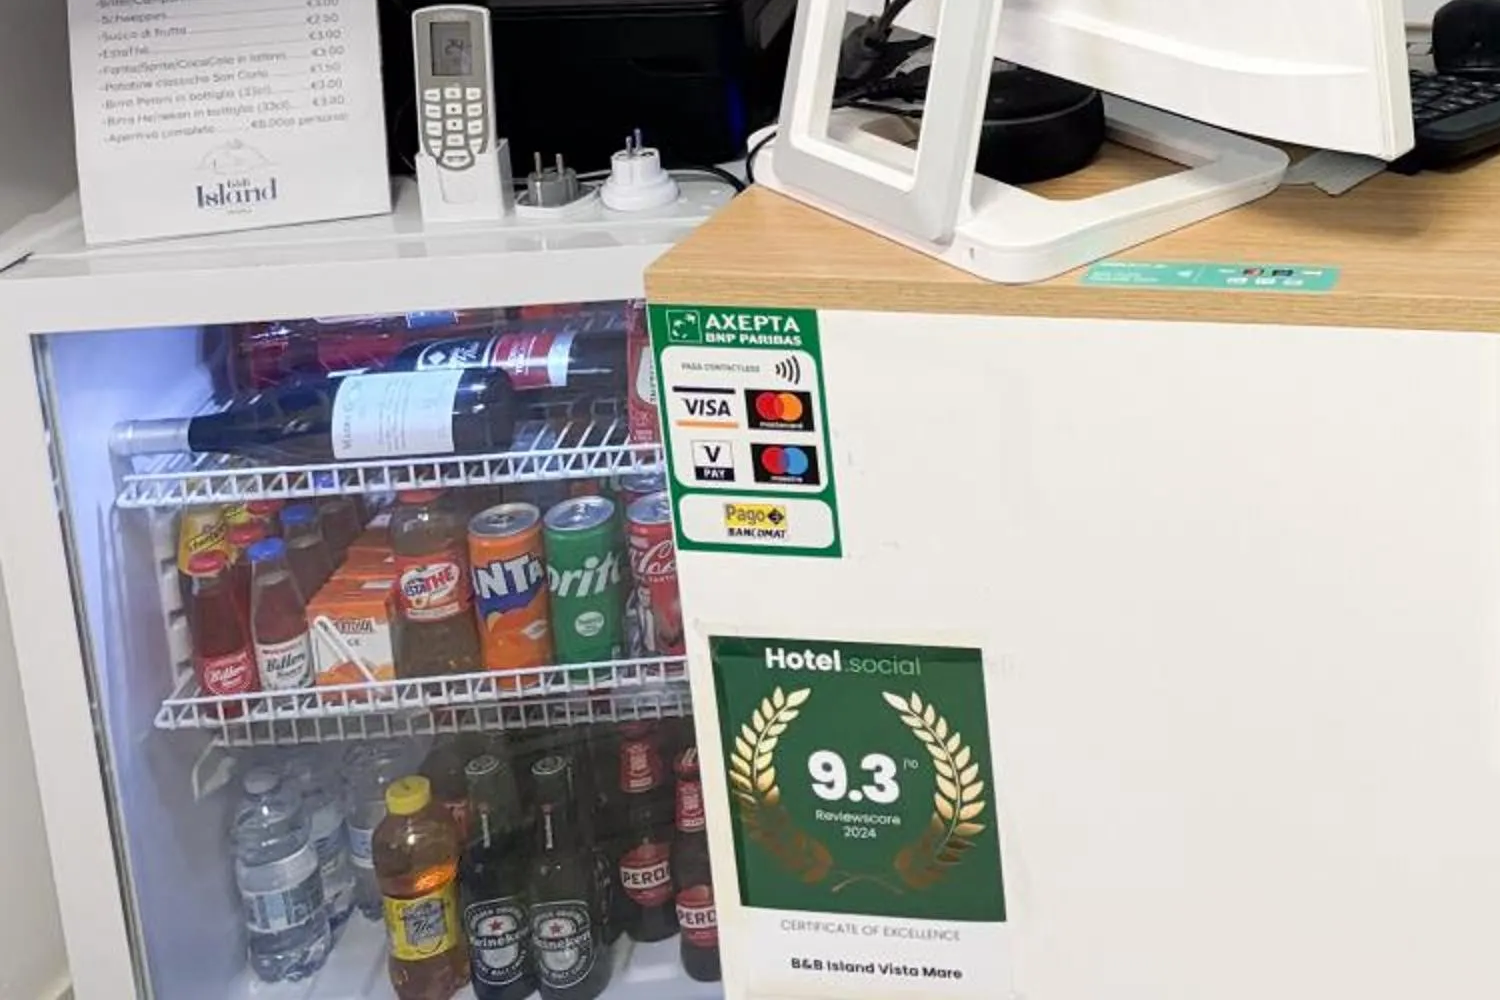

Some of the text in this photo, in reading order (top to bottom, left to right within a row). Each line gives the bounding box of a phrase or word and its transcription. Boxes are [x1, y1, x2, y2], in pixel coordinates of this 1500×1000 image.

[196, 177, 277, 209] Island
[705, 313, 800, 332] AXEPTA
[705, 332, 802, 346] BNP PARIBAS
[683, 399, 732, 416] VISA
[704, 445, 721, 462] V
[704, 468, 726, 479] PAY
[725, 504, 765, 525] Pago
[727, 527, 786, 539] BANCOMAT
[807, 750, 901, 804] 9.3
[815, 810, 901, 826] Reviewscore
[844, 827, 877, 840] 2024
[780, 919, 961, 942] CERTIFICATE OF EXCELLENCE
[791, 957, 963, 980] B&B Island Vista Mare
